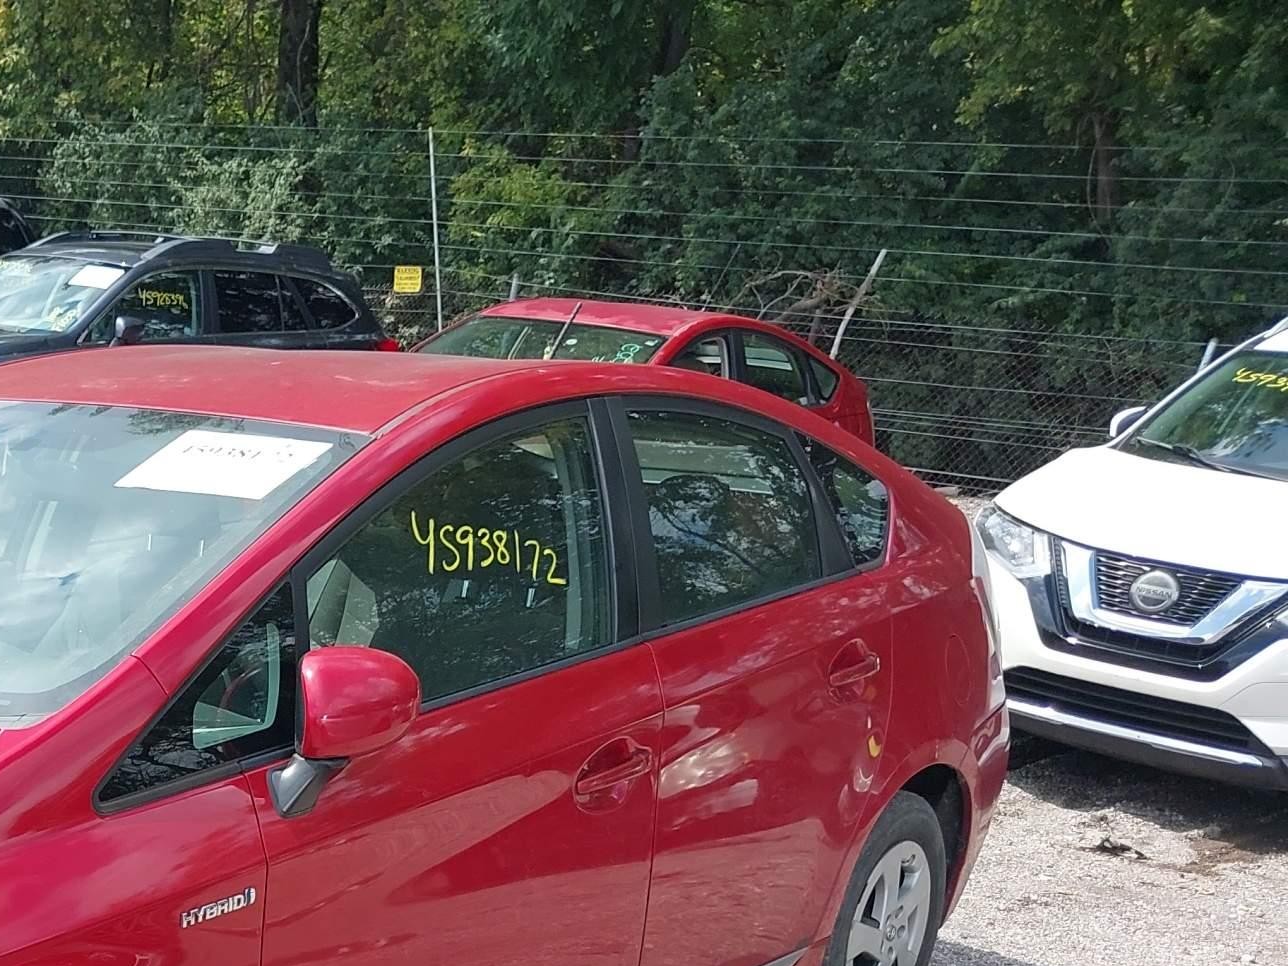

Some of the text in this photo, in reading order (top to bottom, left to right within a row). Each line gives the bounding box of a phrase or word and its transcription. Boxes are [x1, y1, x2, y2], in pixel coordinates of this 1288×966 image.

[411, 510, 567, 585] 45938172
[1136, 586, 1172, 599] NISSAN
[180, 892, 247, 929] HYBRID
